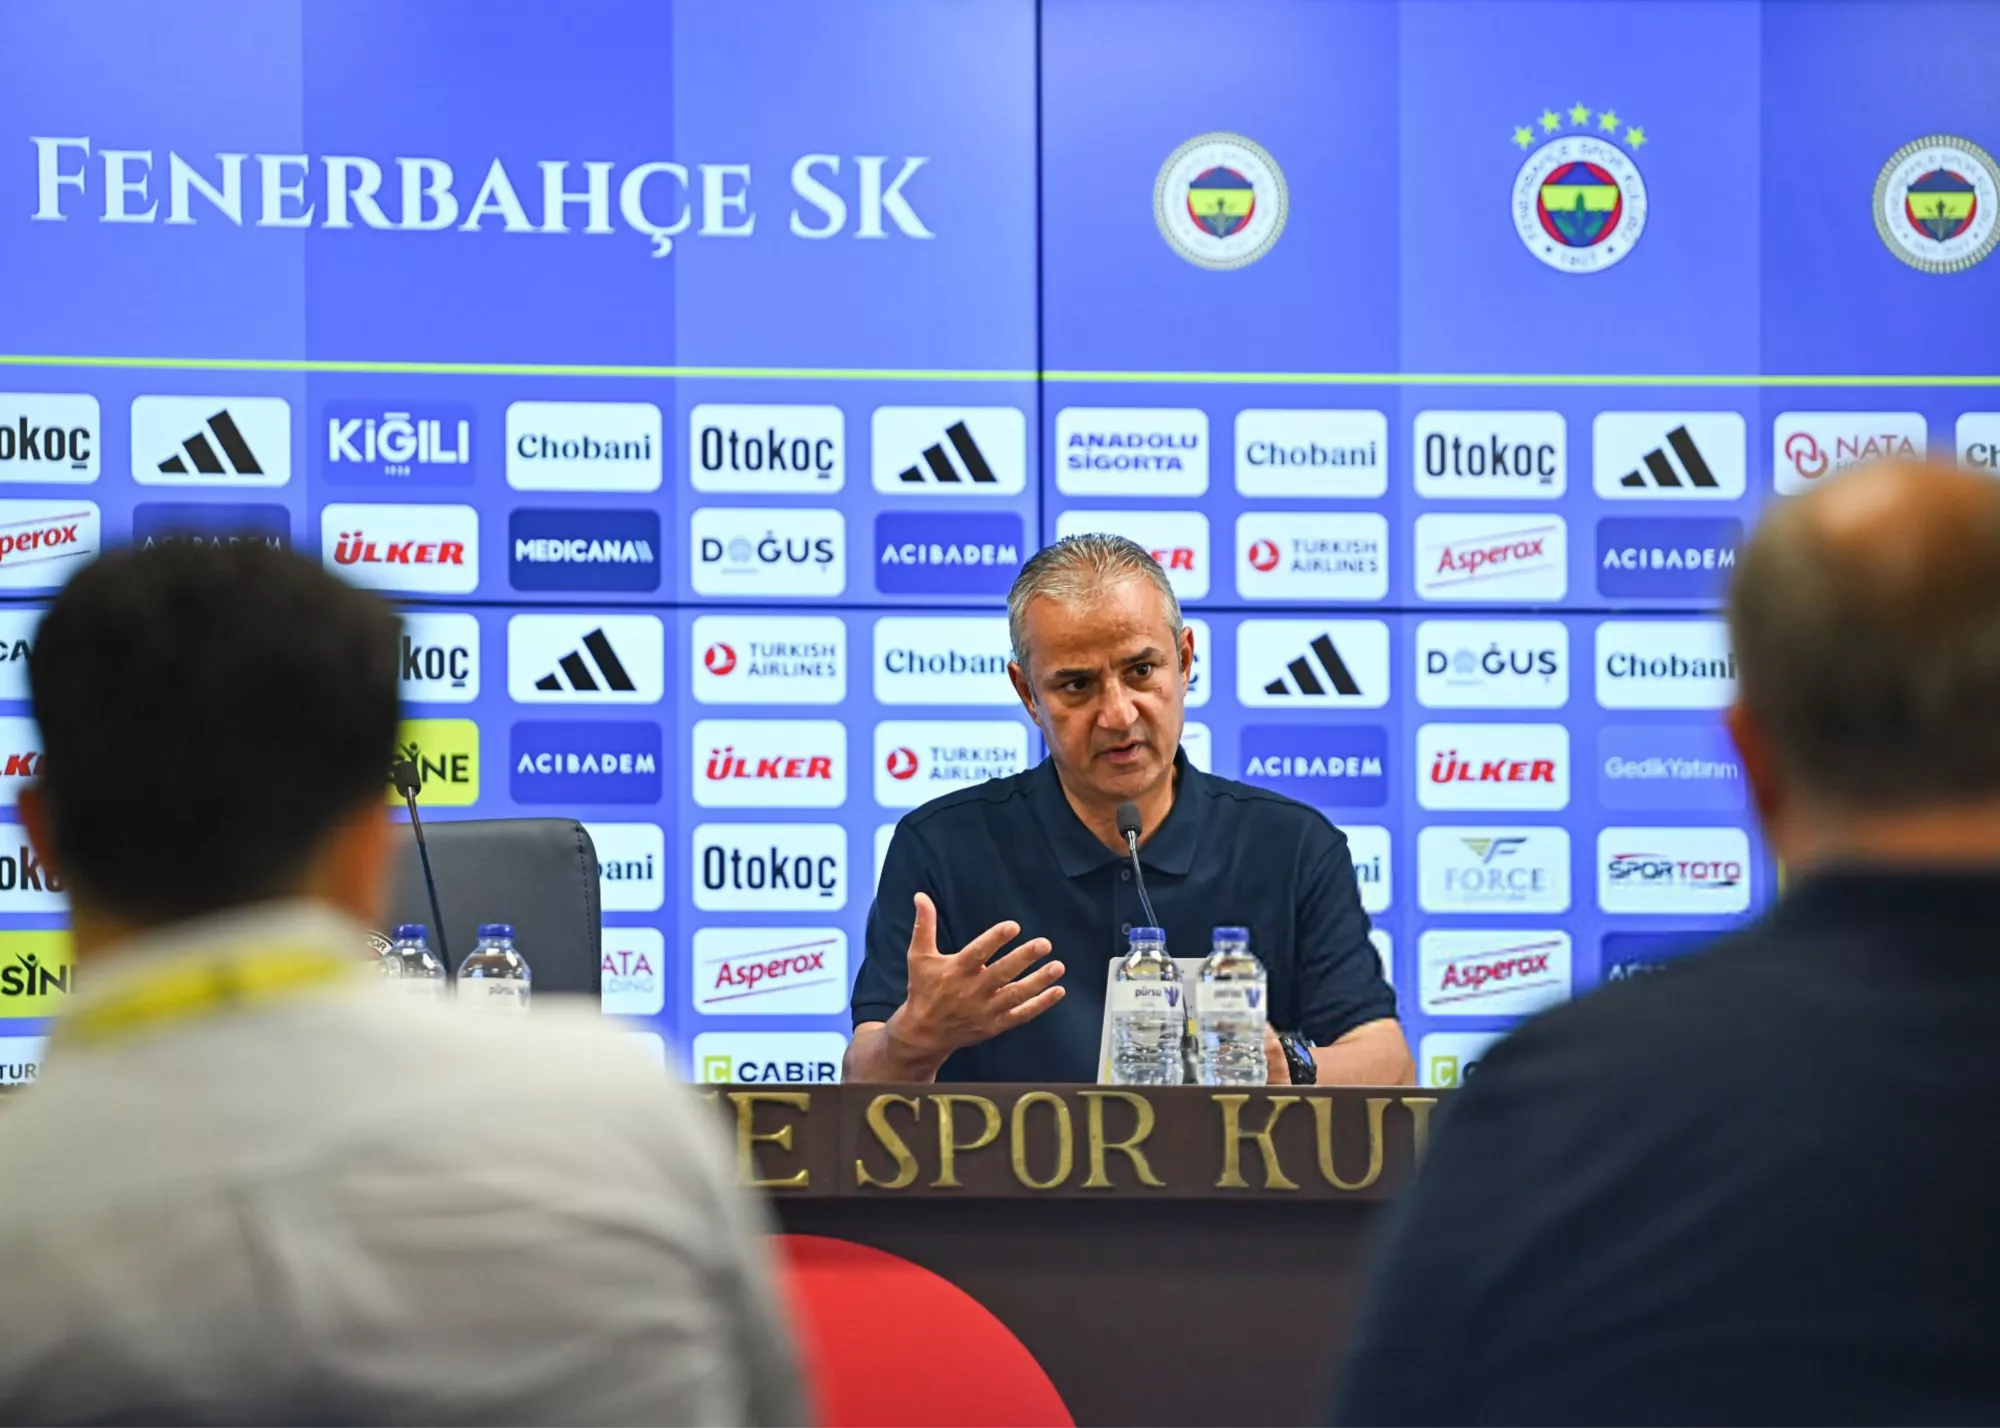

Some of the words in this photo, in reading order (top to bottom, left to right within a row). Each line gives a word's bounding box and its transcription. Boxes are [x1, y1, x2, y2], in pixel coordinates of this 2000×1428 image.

[30, 136, 756, 258] FENERBAHÇE
[790, 153, 936, 239] SK
[517, 433, 652, 462] Chobani
[701, 427, 834, 479] Otokoç
[1068, 432, 1198, 450] ANADOLU
[1246, 440, 1377, 467] Chobani
[1836, 434, 1917, 460] NATA
[1068, 451, 1183, 471] SİGORTA
[1425, 433, 1556, 484] Otokoç
[334, 531, 465, 565] ÜLKER
[515, 538, 638, 564] MEDICANA
[881, 544, 1019, 566] ACIBADEM
[1291, 538, 1379, 556] TURKISH
[1437, 536, 1544, 579] Asperox
[1602, 547, 1736, 570] ACIBADEM
[1290, 556, 1379, 574] AIRLINES
[748, 641, 837, 659] TURKISH
[748, 659, 837, 678] AIRLINES
[1606, 652, 1737, 680] Chobani
[517, 752, 656, 775] ACIBADEM
[706, 746, 832, 781] ÜLKER
[929, 746, 1017, 762] TURKISH
[1245, 755, 1383, 778] ACIBADEM
[1431, 750, 1556, 784] ÜLKER
[703, 846, 837, 896] Otokoç
[1444, 867, 1549, 892] FORCE
[714, 950, 825, 994] Asperox
[1440, 952, 1550, 991] Asperox
[1134, 986, 1162, 998] pürsu
[855, 1090, 1167, 1190] SPOR
